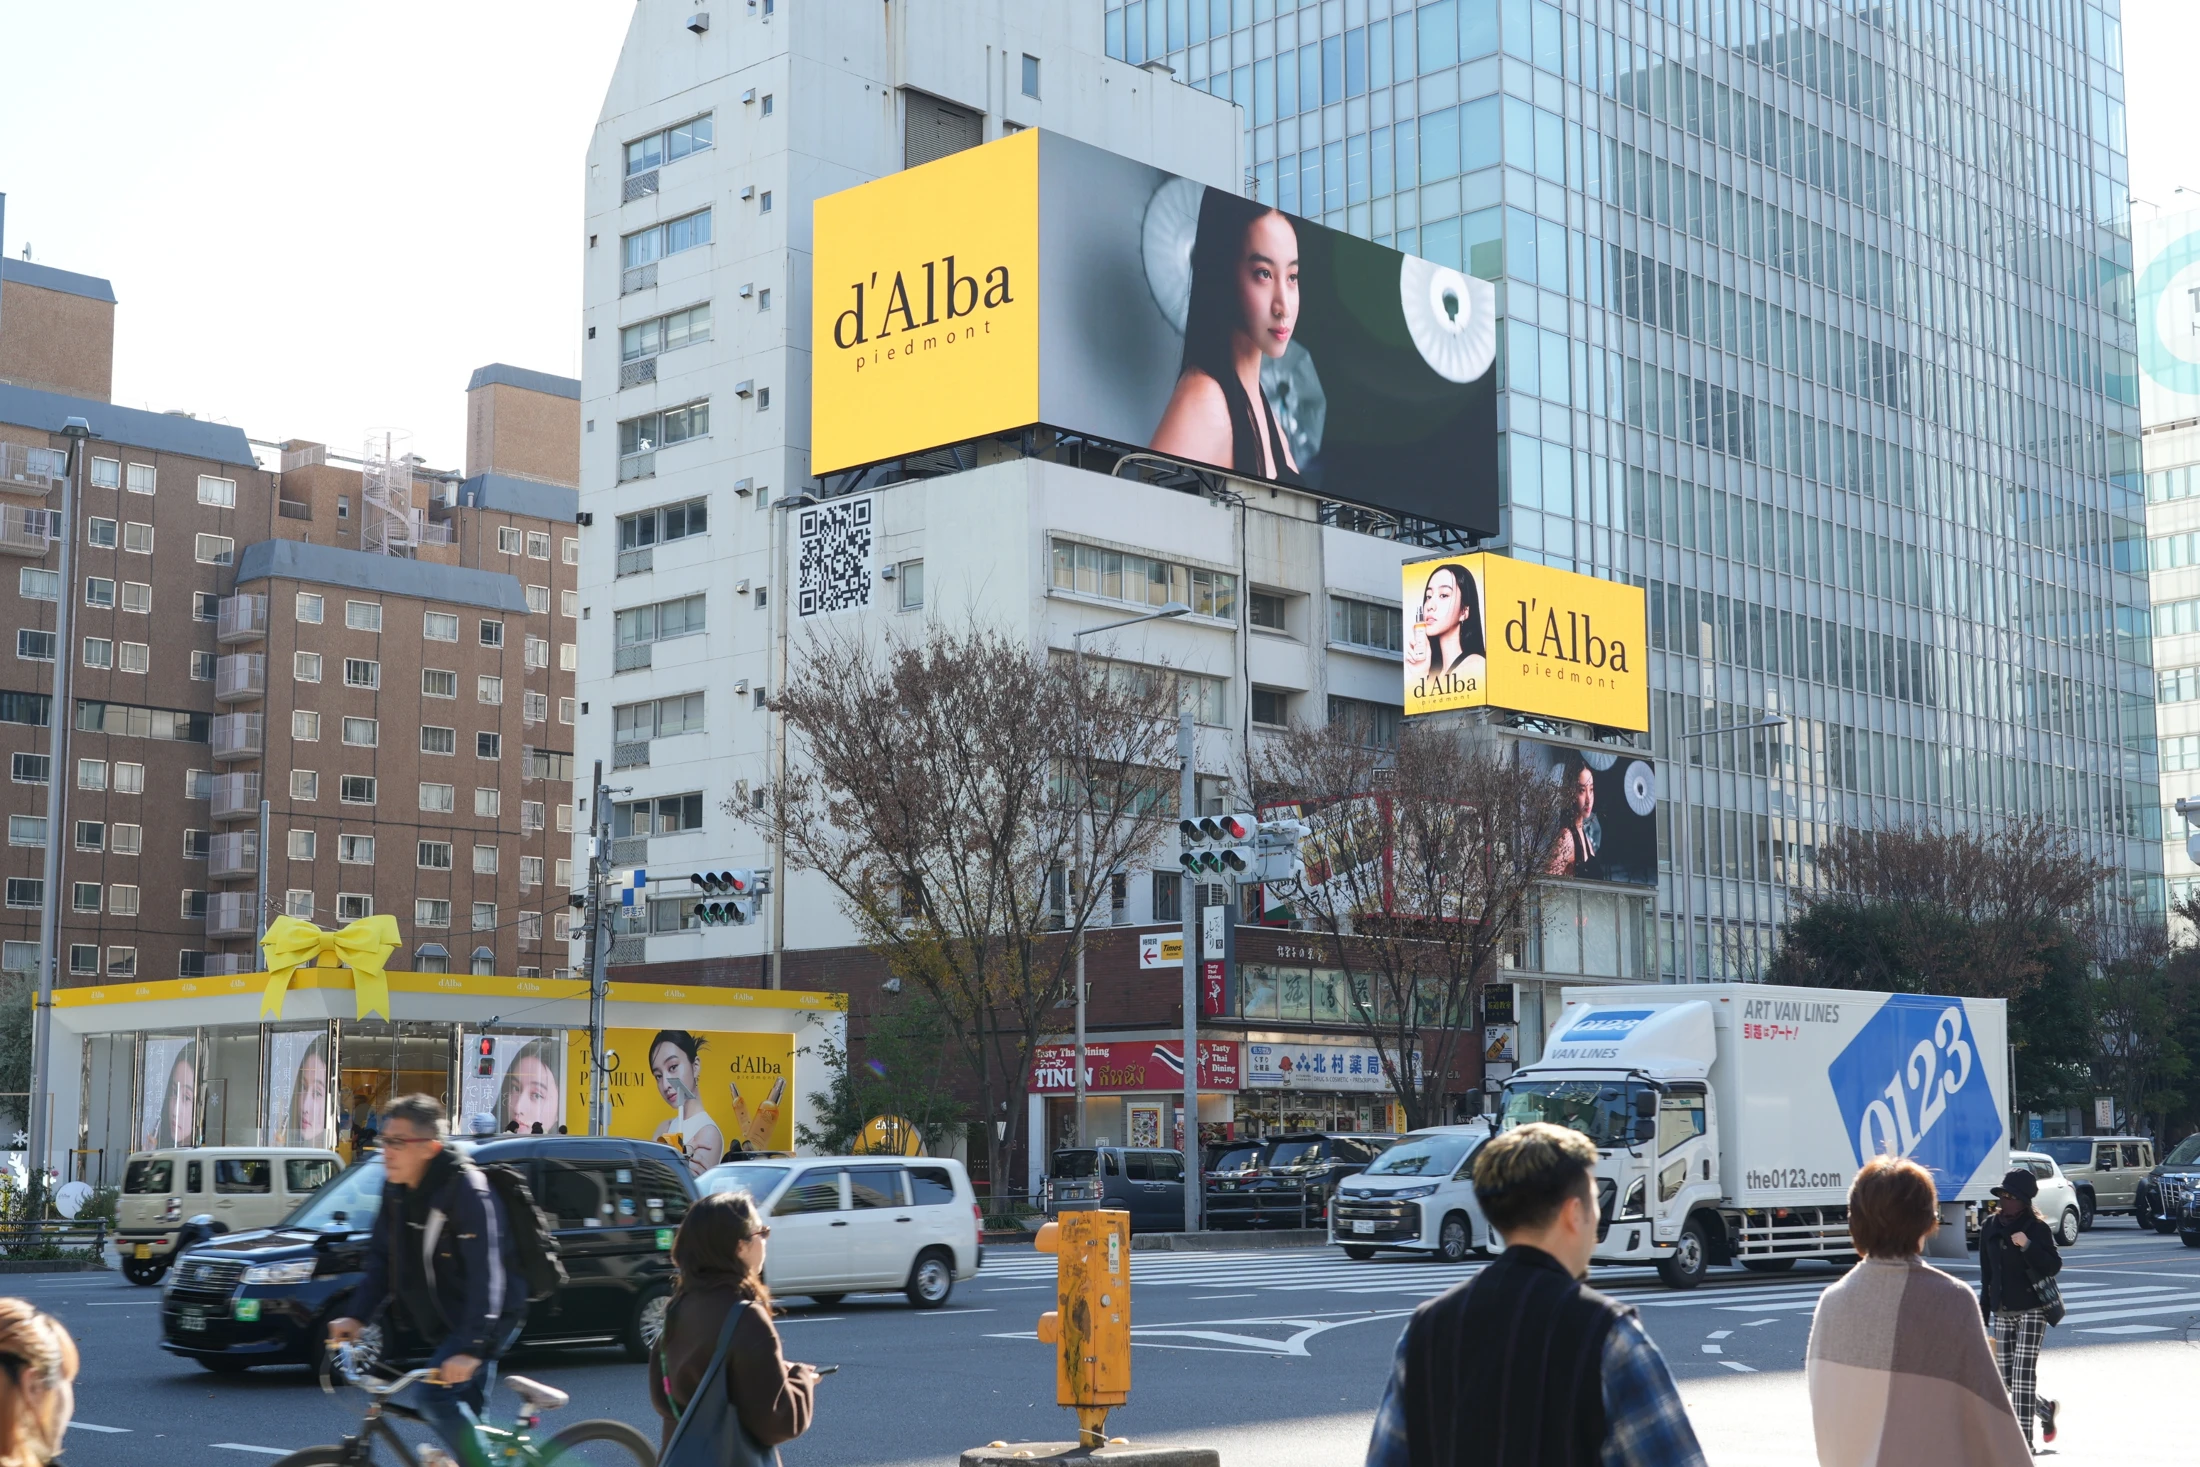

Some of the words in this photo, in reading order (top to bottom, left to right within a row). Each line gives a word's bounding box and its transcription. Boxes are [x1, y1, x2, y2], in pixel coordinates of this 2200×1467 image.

[833, 255, 1014, 349] d'Alba
[856, 320, 991, 372] piedmont
[1505, 597, 1629, 673] d'Alba
[1522, 662, 1616, 690] piedmont
[1413, 673, 1477, 699] d'Alba
[1421, 694, 1471, 706] piedmont
[622, 906, 645, 917] 時差式
[1163, 944, 1182, 952] Times
[438, 977, 462, 988] d'Alba
[517, 981, 540, 991] d'Alba
[664, 989, 685, 998] d'Alba
[733, 992, 754, 1001] d'Alba
[799, 995, 819, 1004] d'Alba
[1744, 1000, 1771, 1020] ART
[1774, 1001, 1801, 1021] VAN
[1804, 1003, 1840, 1024] LINES
[1572, 1018, 1641, 1031] 0123
[1035, 1049, 1058, 1059] Tasty
[1060, 1048, 1075, 1057] Tha
[1211, 1044, 1231, 1054] Tasty
[1551, 1049, 1578, 1059] VAN
[1580, 1048, 1619, 1059] LINES
[1039, 1059, 1067, 1068] ティーヌン
[1211, 1054, 1228, 1062] Thai
[730, 1054, 782, 1074] d'Alba
[1211, 1064, 1236, 1074] Dining
[1313, 1053, 1379, 1075] 北村薬局
[1213, 1076, 1235, 1084] ティーヌン
[1859, 1006, 1972, 1168] 0123
[1746, 1168, 1841, 1189] the0123.com
